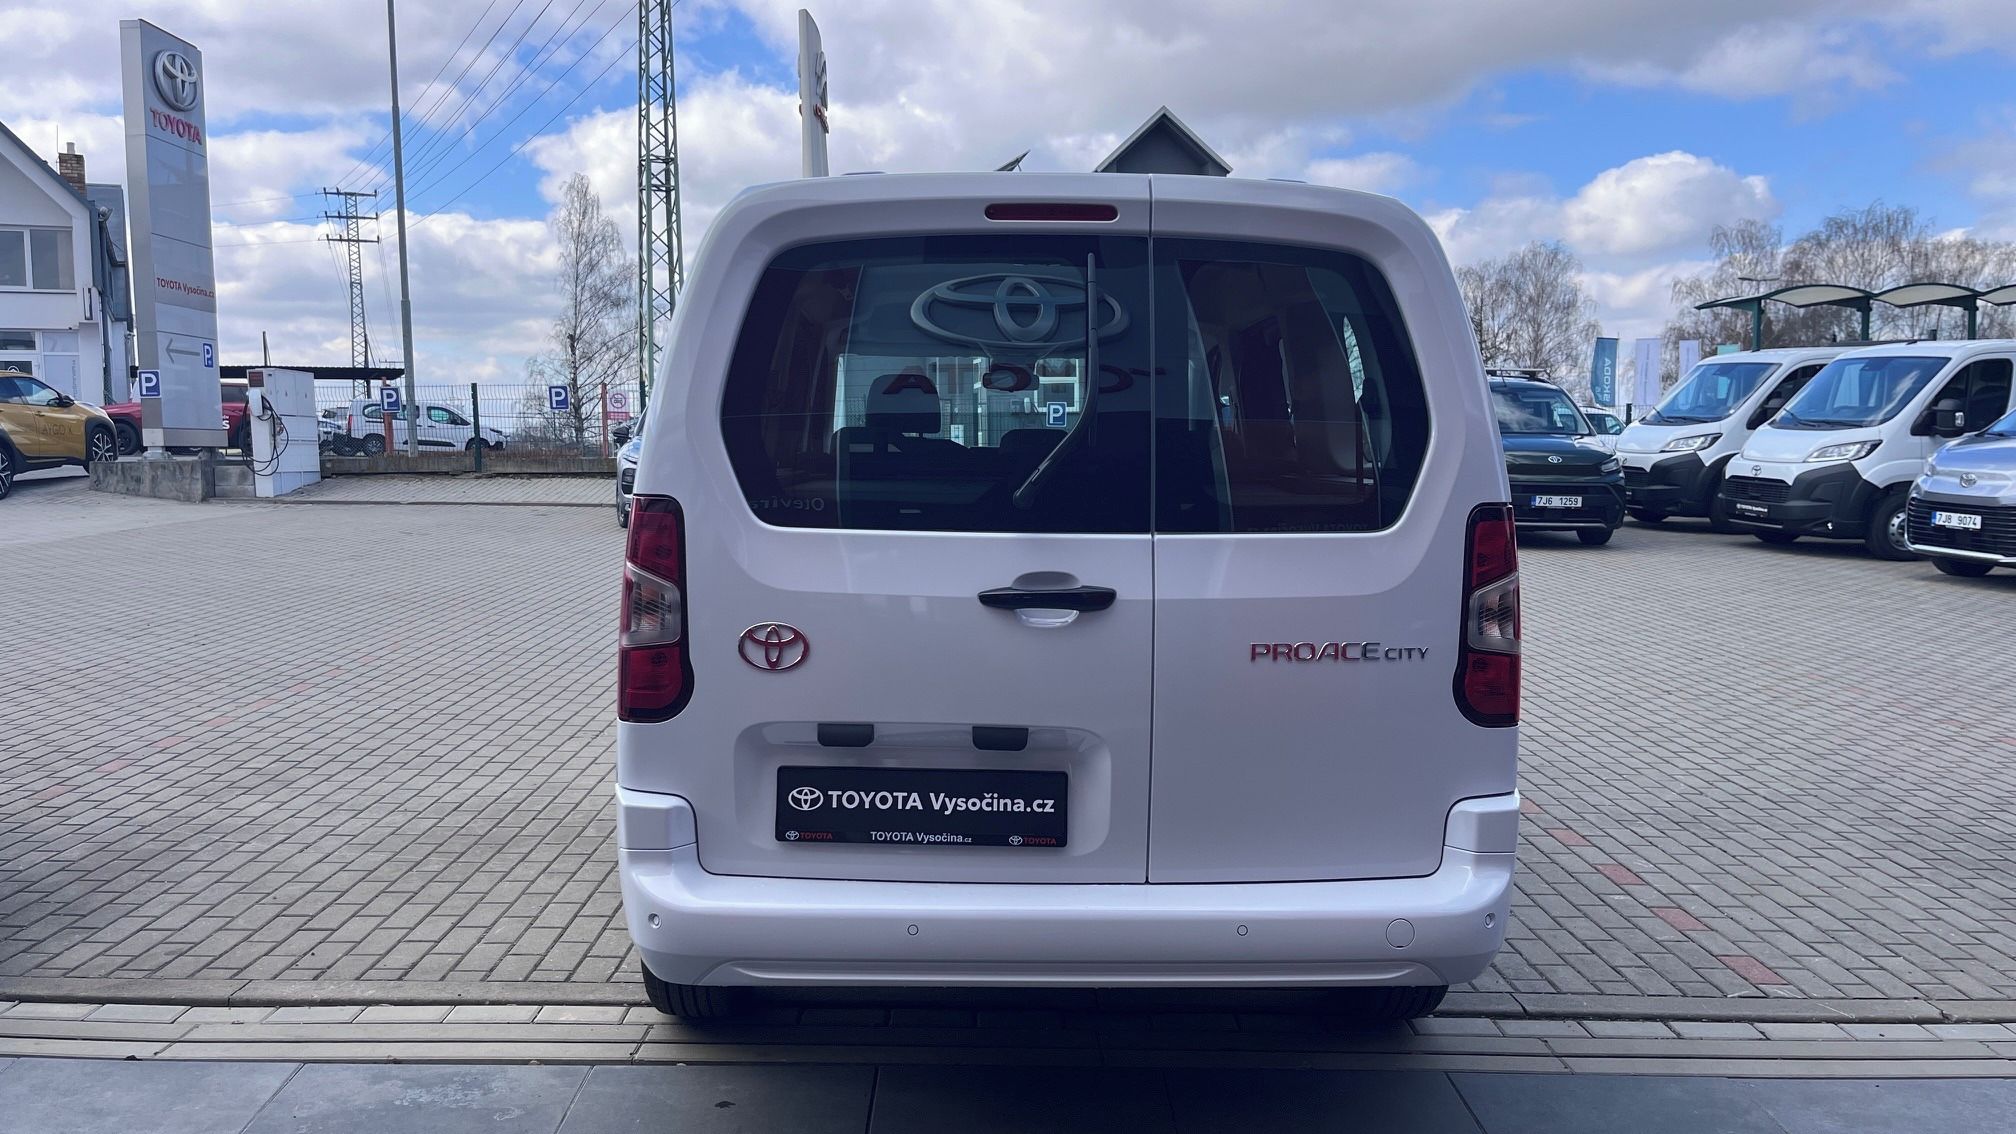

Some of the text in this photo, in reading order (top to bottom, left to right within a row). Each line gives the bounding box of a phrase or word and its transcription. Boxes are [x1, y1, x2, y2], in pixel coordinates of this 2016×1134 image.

[150, 107, 202, 145] TOYOTA
[156, 277, 182, 291] TOYOTA
[141, 373, 157, 395] P
[382, 389, 397, 410] P
[551, 388, 566, 408] P
[1050, 405, 1063, 423] P
[1537, 497, 1579, 506] 7J6 1259
[1957, 515, 1977, 526] 9074
[1250, 641, 1429, 662] PROACE CITY
[827, 790, 1055, 815] TOYOTA Vysočina.cz
[800, 832, 833, 840] TOYOTA
[870, 831, 972, 844] TOYOTA Vysočina.cz
[1024, 837, 1057, 845] TOYOTA
